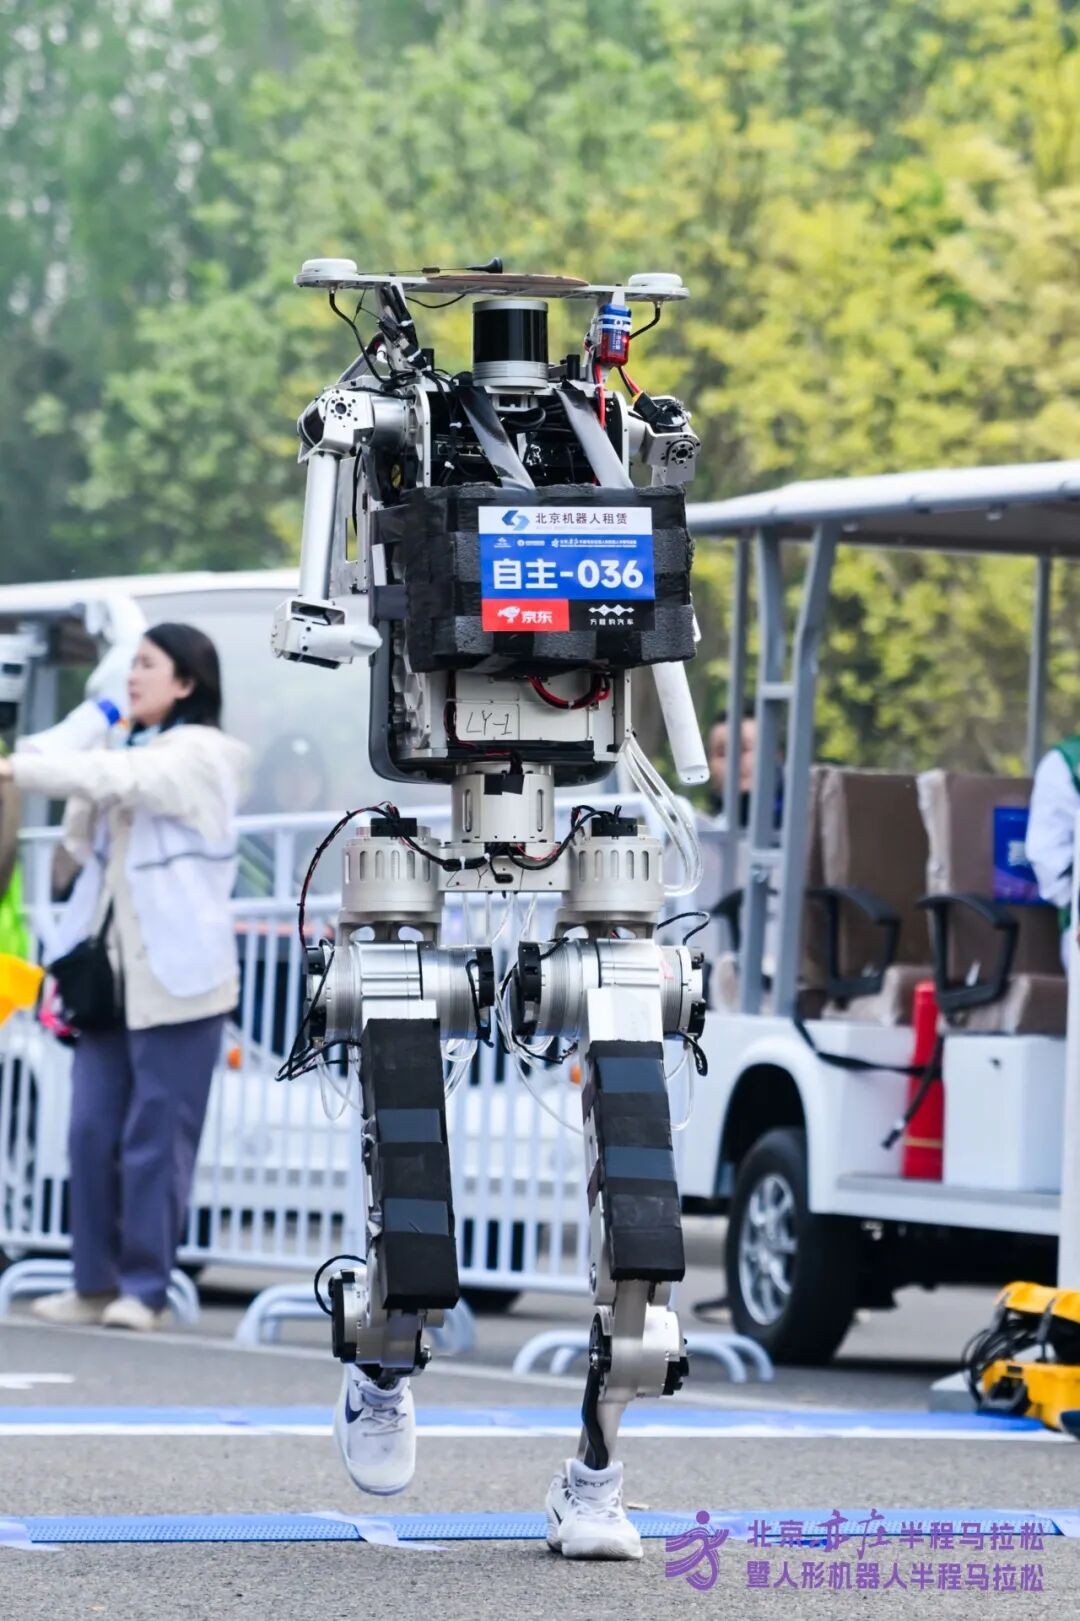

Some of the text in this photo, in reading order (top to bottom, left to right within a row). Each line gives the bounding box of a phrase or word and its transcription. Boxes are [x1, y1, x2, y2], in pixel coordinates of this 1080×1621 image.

[535, 512, 628, 525] 北京机器人租赁
[493, 558, 644, 590] 自主-036
[521, 610, 553, 624] 京东
